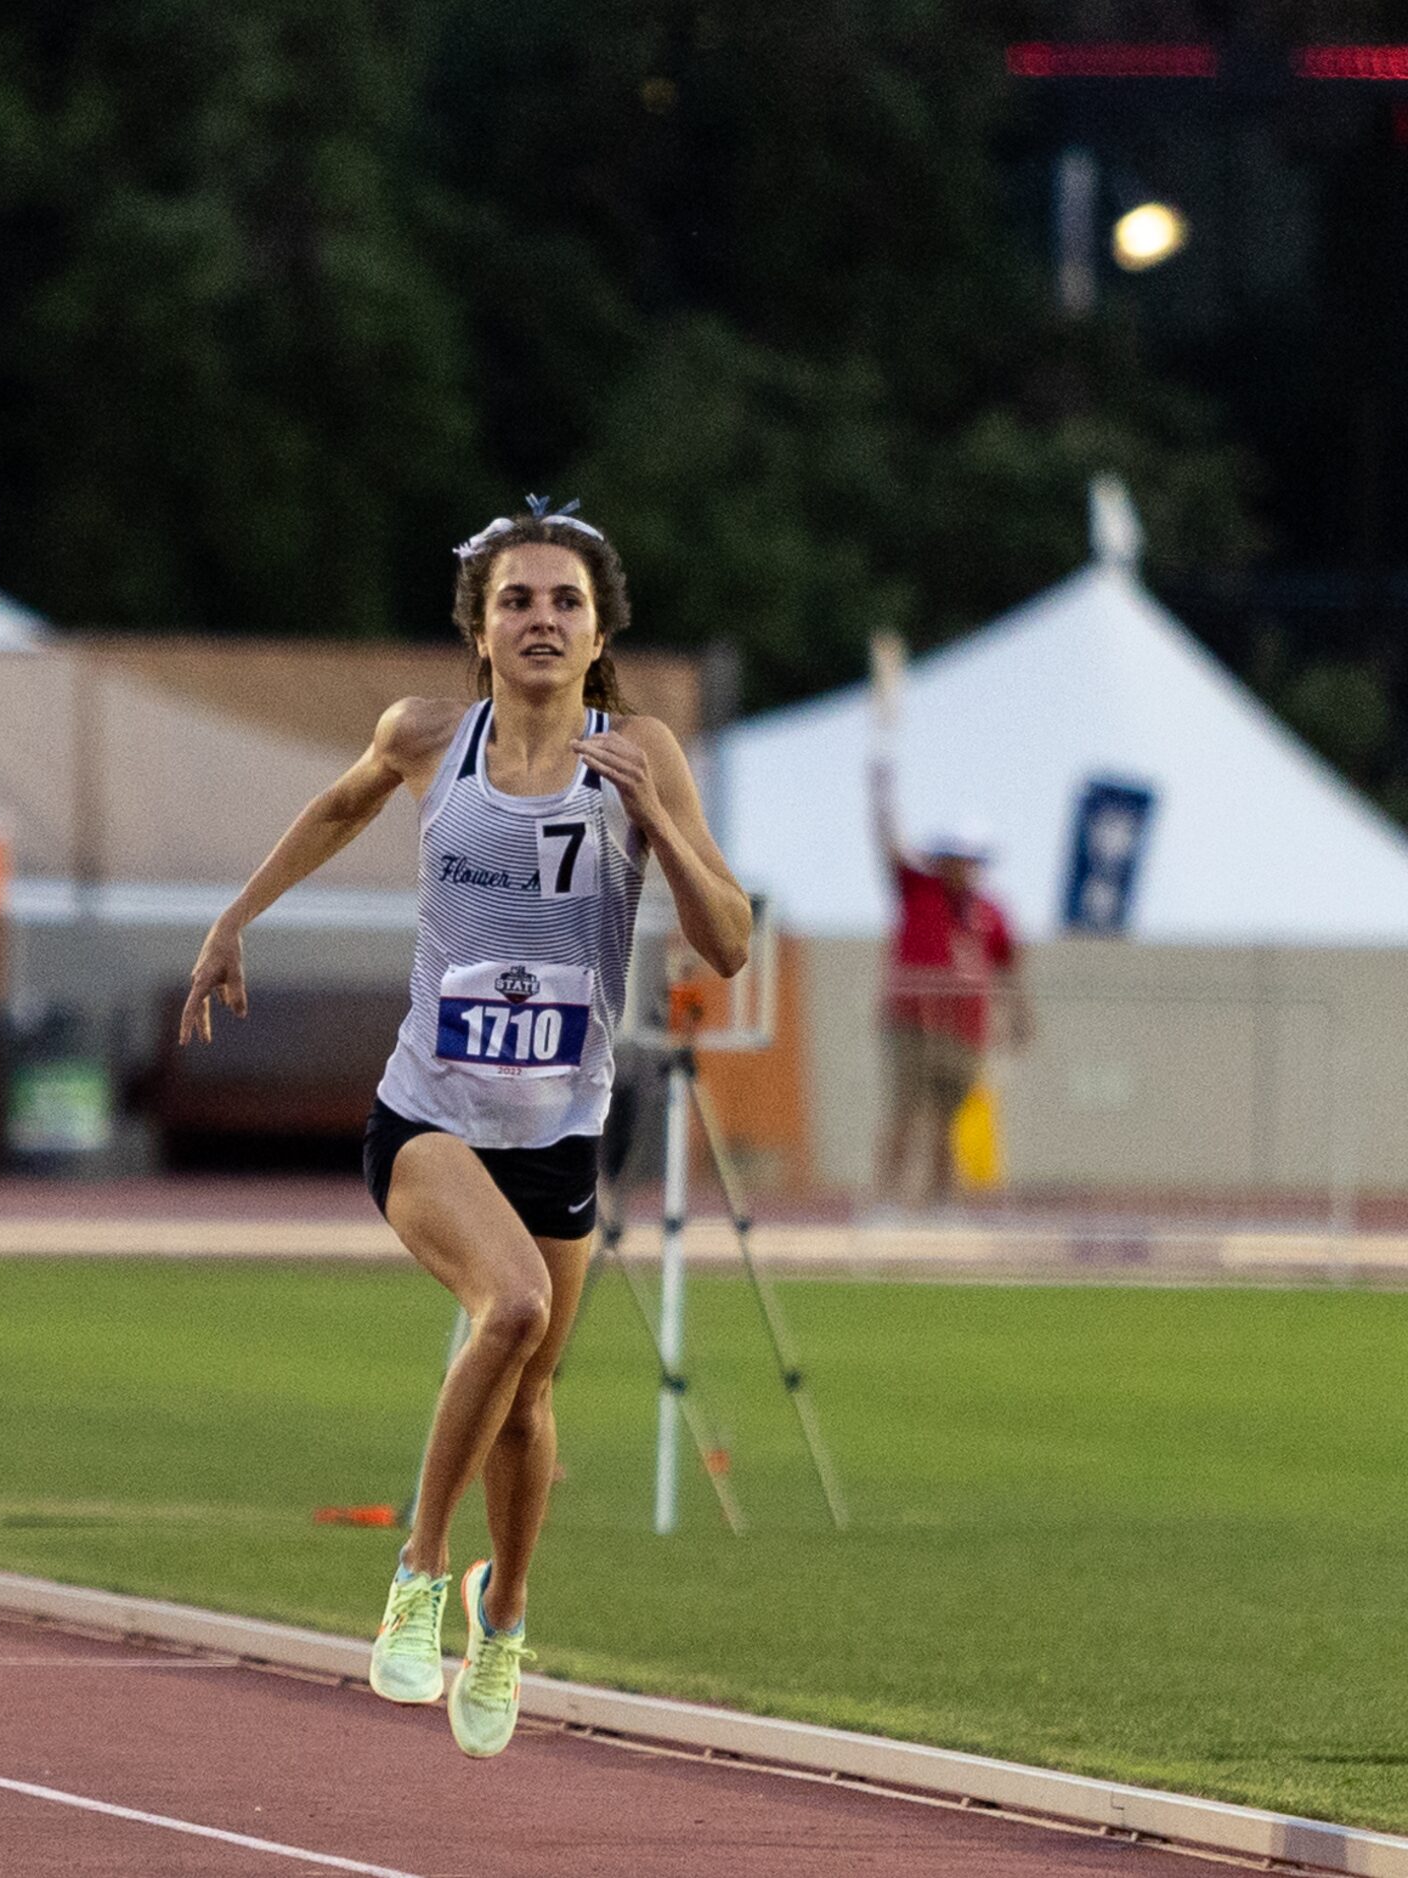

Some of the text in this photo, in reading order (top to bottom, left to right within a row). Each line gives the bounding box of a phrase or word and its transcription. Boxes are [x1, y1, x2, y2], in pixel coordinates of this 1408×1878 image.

[439, 855, 511, 887] Flower
[543, 822, 586, 893] 7
[495, 978, 540, 992] STATE
[461, 1005, 562, 1060] 1710
